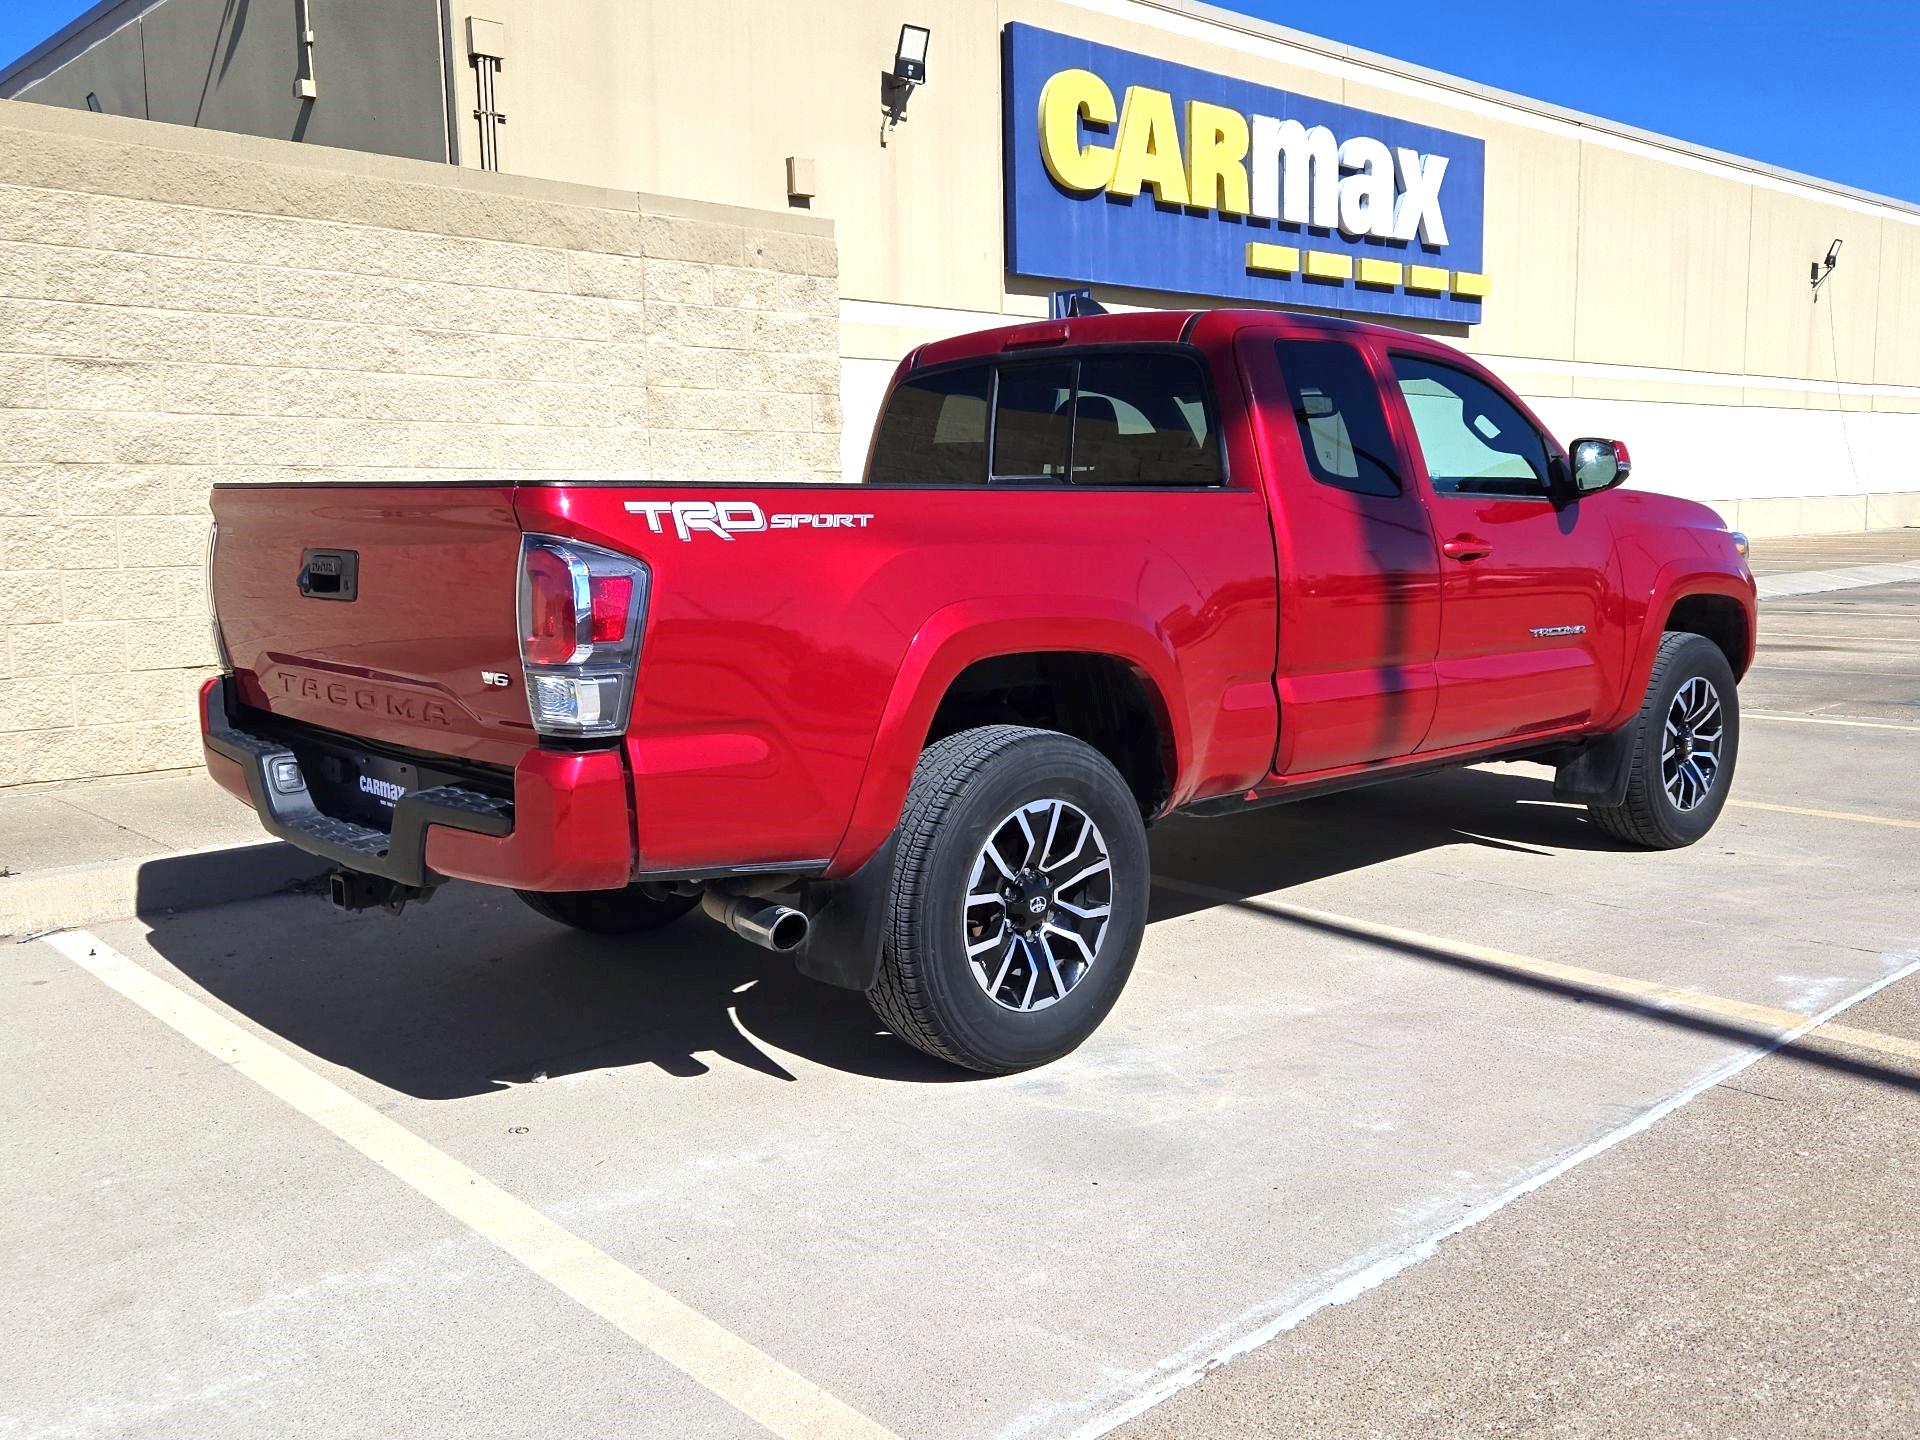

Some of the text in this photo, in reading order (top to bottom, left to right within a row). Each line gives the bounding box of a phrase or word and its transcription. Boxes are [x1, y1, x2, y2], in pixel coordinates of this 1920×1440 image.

[1038, 68, 1450, 246] CARmax
[624, 501, 874, 541] TRD SPORT
[277, 672, 450, 724] TACOMA
[481, 671, 509, 687] V6
